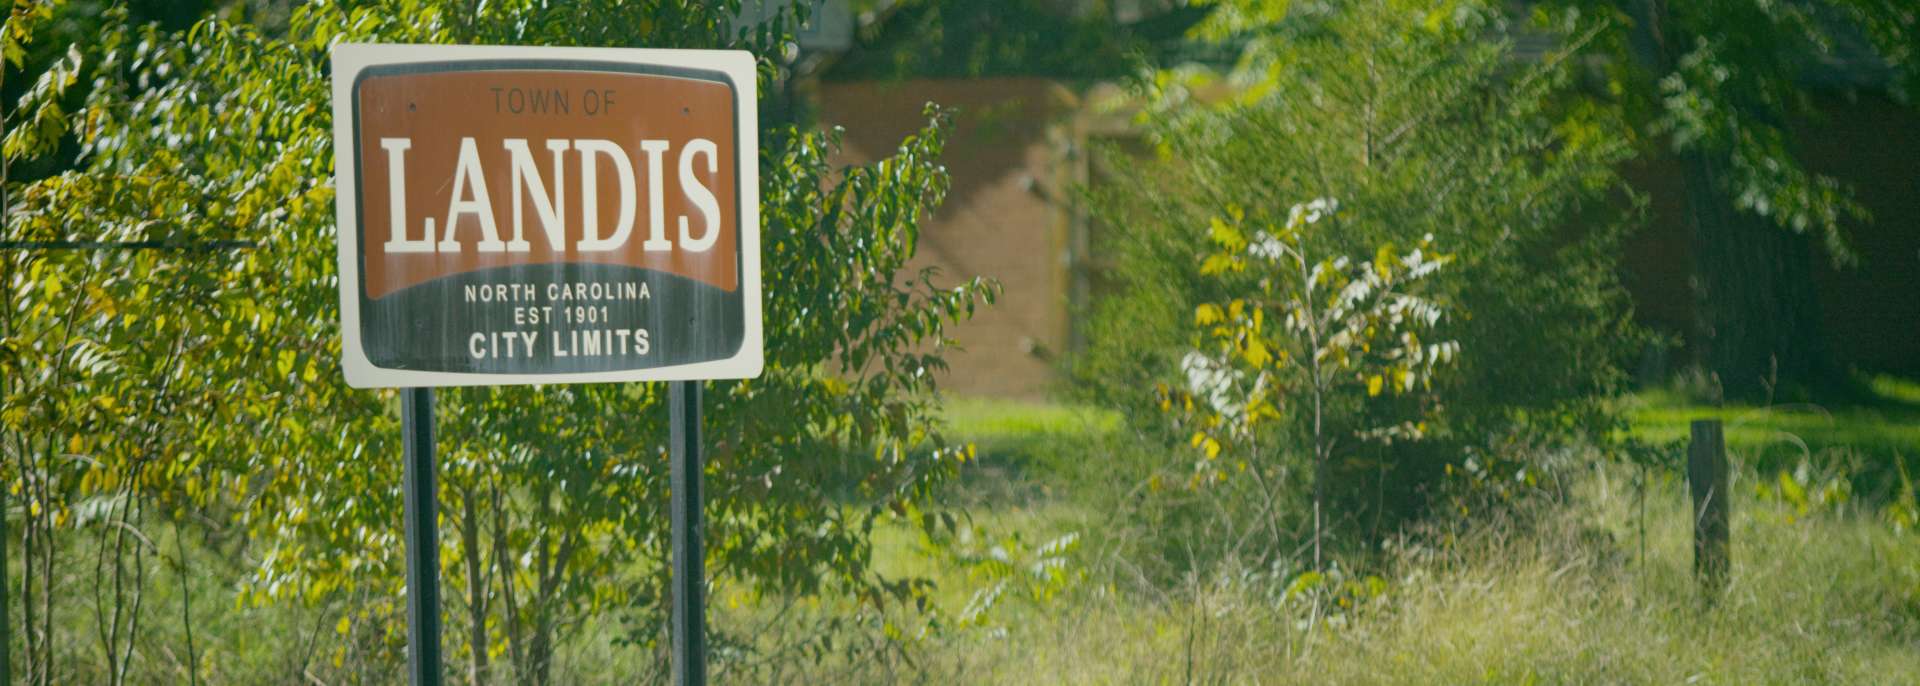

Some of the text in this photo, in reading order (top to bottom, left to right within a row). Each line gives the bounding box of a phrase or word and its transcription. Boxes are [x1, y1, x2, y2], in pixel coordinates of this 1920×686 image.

[490, 87, 617, 116] TOWN OF
[380, 136, 721, 254] LANDIS
[464, 282, 651, 302] NORTH CAROLINA
[514, 306, 609, 325] EST 1901
[469, 328, 650, 360] CITY LIMITS
